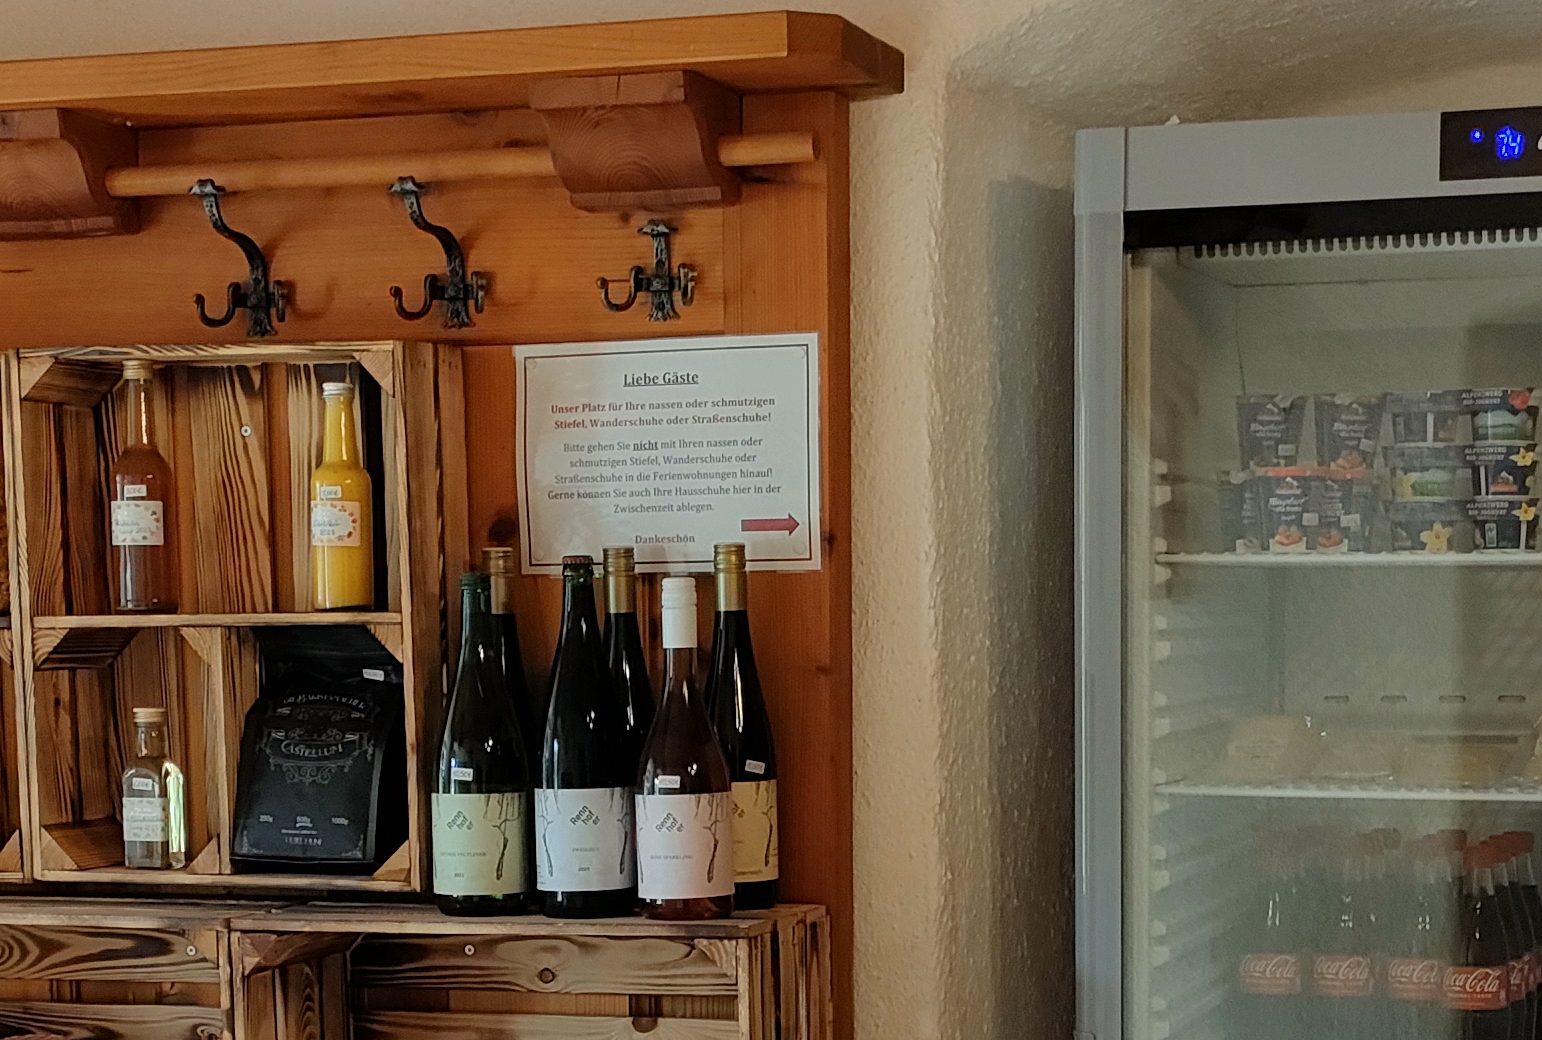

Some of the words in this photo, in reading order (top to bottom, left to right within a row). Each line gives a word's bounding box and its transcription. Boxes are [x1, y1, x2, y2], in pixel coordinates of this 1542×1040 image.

[623, 373, 659, 387] Liebe
[662, 371, 699, 385] Gäste
[551, 404, 580, 414] Unser
[581, 403, 606, 413] Platz
[608, 402, 623, 411] für
[625, 401, 646, 411] Ihre
[648, 401, 683, 410] nassen
[685, 399, 709, 408] oder
[711, 397, 775, 408] schmutzigen
[554, 418, 588, 429] Stiefel,
[589, 416, 664, 428] Wanderschuhe
[666, 415, 689, 425] oder
[691, 412, 772, 424] Straßenschuhe!
[563, 443, 585, 453] Bitte
[587, 441, 615, 454] gehen
[616, 441, 631, 451] Sie
[633, 440, 659, 451] nicht
[660, 440, 676, 449] mit
[678, 439, 704, 449] Ihren
[706, 439, 739, 448] nassen
[740, 437, 763, 446] oder
[569, 457, 628, 469] schmutzigen
[629, 456, 661, 466] Stiefel,
[662, 453, 733, 465] Wanderschuhe
[734, 453, 757, 463] oder
[554, 472, 623, 484] Straßenschuhe
[625, 473, 634, 482] in
[636, 472, 651, 481] die
[653, 470, 737, 482] Ferienwohnungen
[547, 490, 575, 500] Gerne
[576, 489, 611, 499] können
[612, 488, 627, 498] Sie
[628, 487, 651, 498] auch
[653, 487, 673, 497] Ihre
[675, 485, 731, 496] Hausschuhe
[732, 485, 752, 494] hier
[753, 484, 763, 494] in
[765, 484, 782, 494] der
[613, 503, 674, 514] Zwischenzeit
[676, 502, 715, 514] ablegen.
[635, 533, 695, 544] Dankeschön
[446, 810, 464, 830] Renn
[456, 815, 469, 830] hof
[569, 805, 589, 826] Renn
[581, 809, 595, 826] hof
[592, 815, 601, 826] er
[655, 812, 673, 833] Renn
[665, 817, 680, 833] hof
[1443, 966, 1503, 992] Coca-Cola
